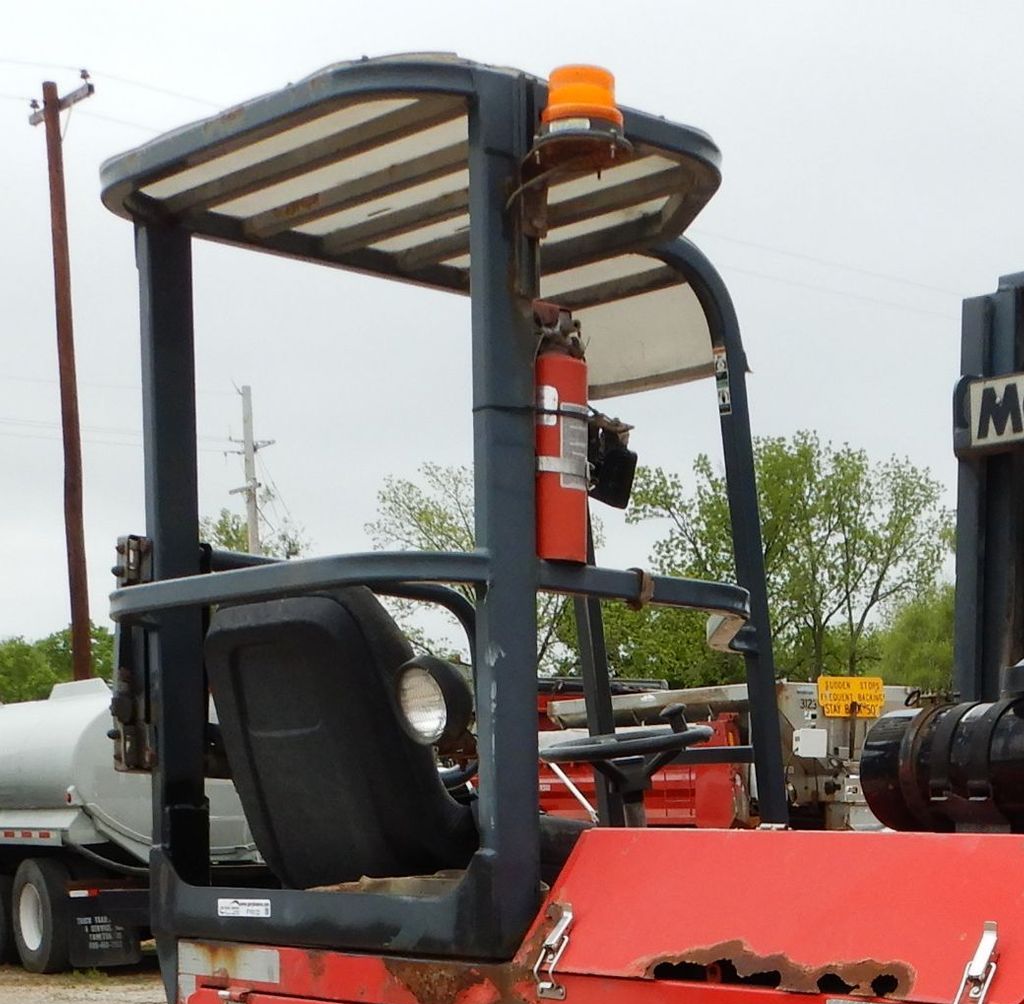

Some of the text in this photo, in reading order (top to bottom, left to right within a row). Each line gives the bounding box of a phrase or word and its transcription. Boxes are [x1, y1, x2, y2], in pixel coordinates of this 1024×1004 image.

[825, 681, 880, 691] SUDDEN STOPS
[800, 698, 817, 712] 3123
[825, 703, 842, 714] STAY
